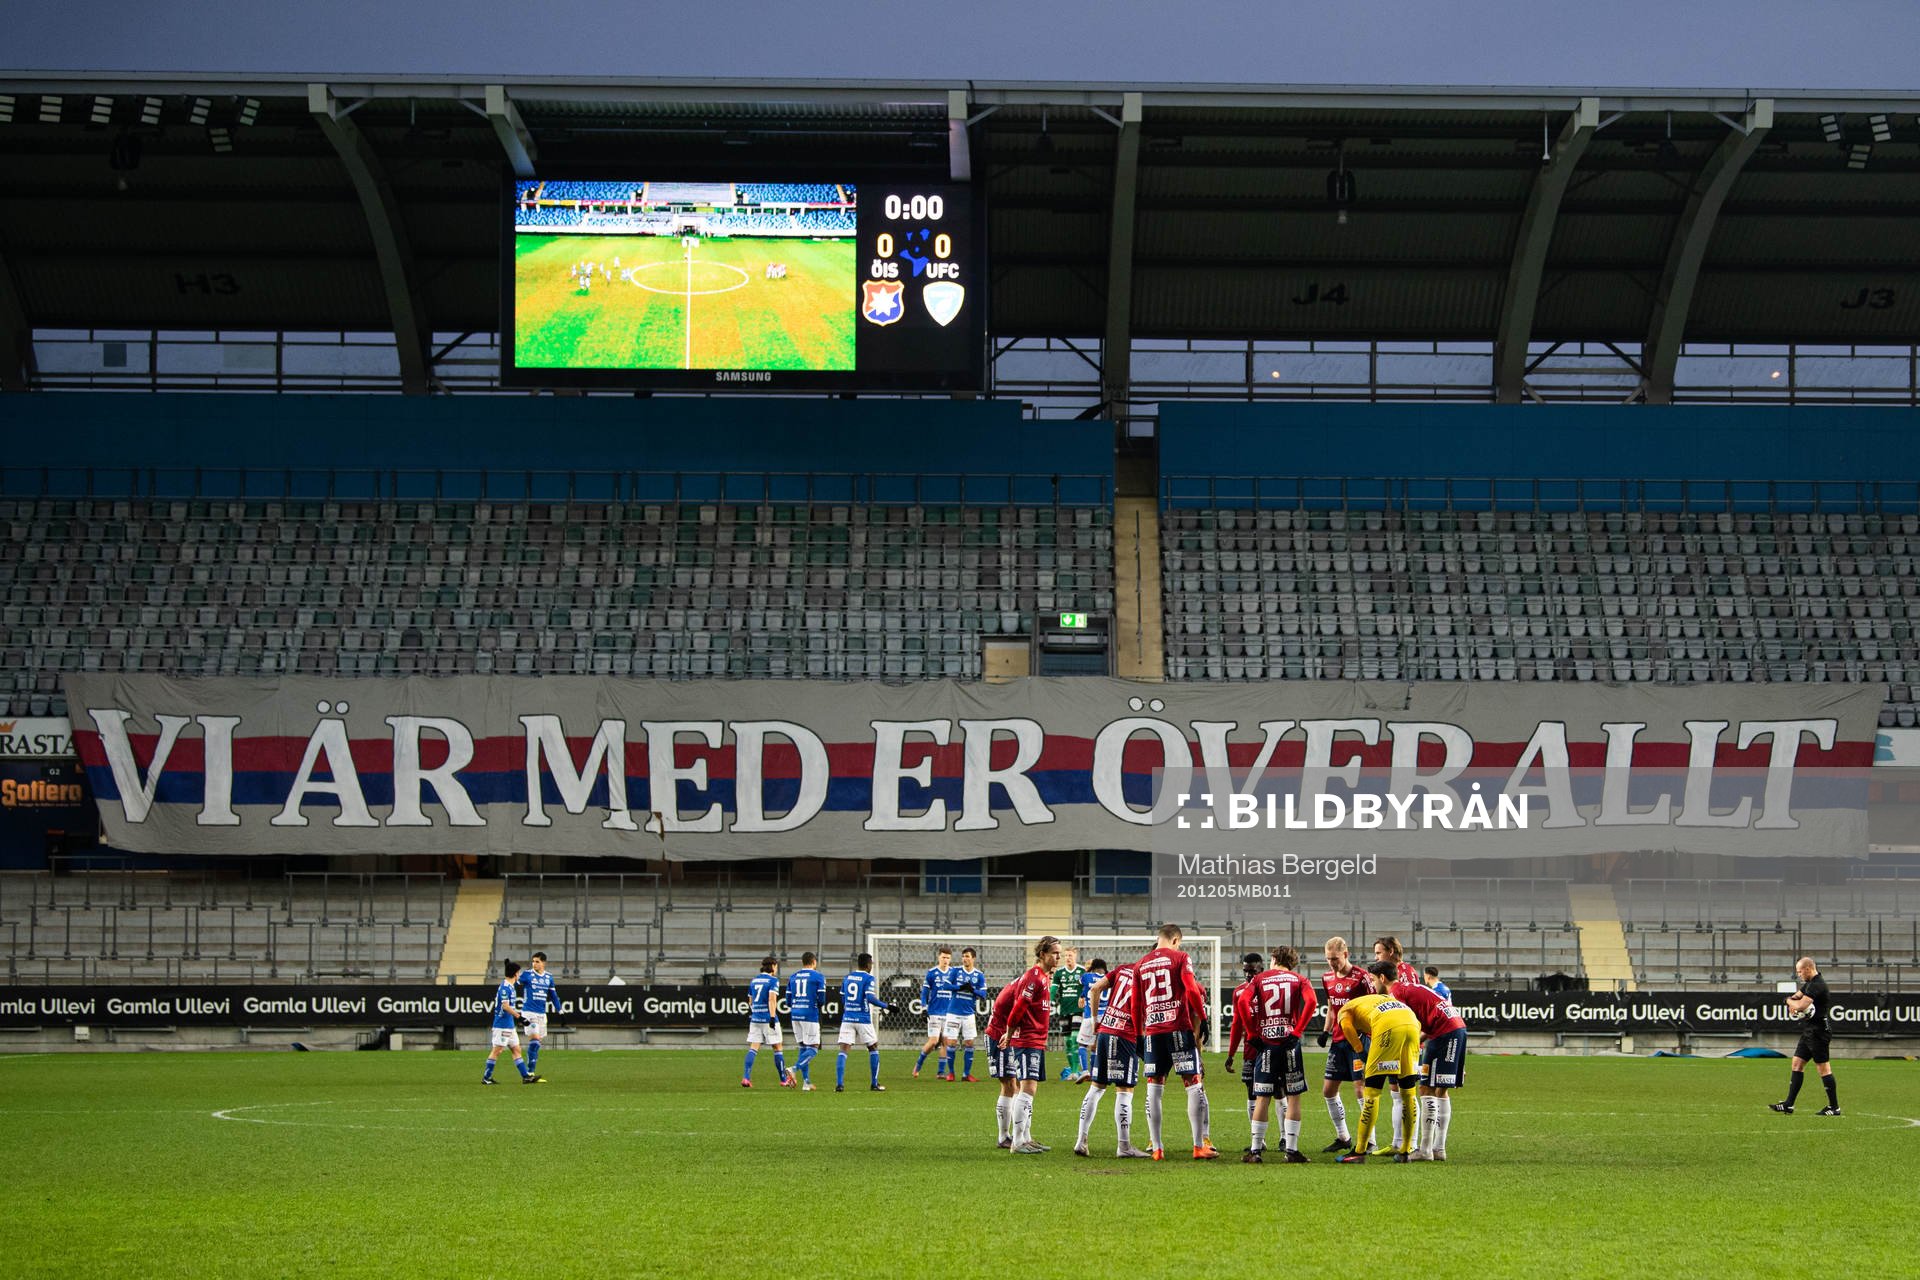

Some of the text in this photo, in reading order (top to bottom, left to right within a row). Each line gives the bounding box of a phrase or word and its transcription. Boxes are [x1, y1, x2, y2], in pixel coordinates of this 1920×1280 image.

[885, 195, 943, 220] 0:00
[877, 233, 951, 258] 0 0
[871, 259, 899, 278] ÖIS
[926, 263, 960, 278] UFC
[174, 271, 240, 295] H3
[1292, 282, 1350, 306] J4
[1840, 287, 1895, 309] J3
[716, 371, 771, 382] SAMSUNG
[88, 695, 1840, 833] VI ÄR MED ER ÖVERALLT
[1, 779, 82, 807] Sofiero
[754, 984, 764, 1002] 7
[795, 979, 807, 997] 11
[847, 983, 858, 1001] 9
[1141, 969, 1173, 1005] 23
[41, 998, 95, 1014] Ullevi
[107, 998, 230, 1015] Gamla Ullevi
[243, 997, 365, 1013] Gamla Ullevi
[377, 997, 496, 1013] Gamla Ullev
[579, 997, 632, 1014] Ullevi
[644, 997, 706, 1014] Gamla
[711, 997, 750, 1014] Ulle
[1262, 982, 1291, 1017] 21
[1501, 1003, 1554, 1020] Ullevi
[1565, 1003, 1685, 1021] Gamla Ullevi
[1696, 1004, 1758, 1021] Gamla
[1829, 1005, 1890, 1022] Gamla
[1263, 1025, 1286, 1038] BESAB
[1120, 1103, 1128, 1129] MIKE
[1361, 1099, 1375, 1125] MIKE
